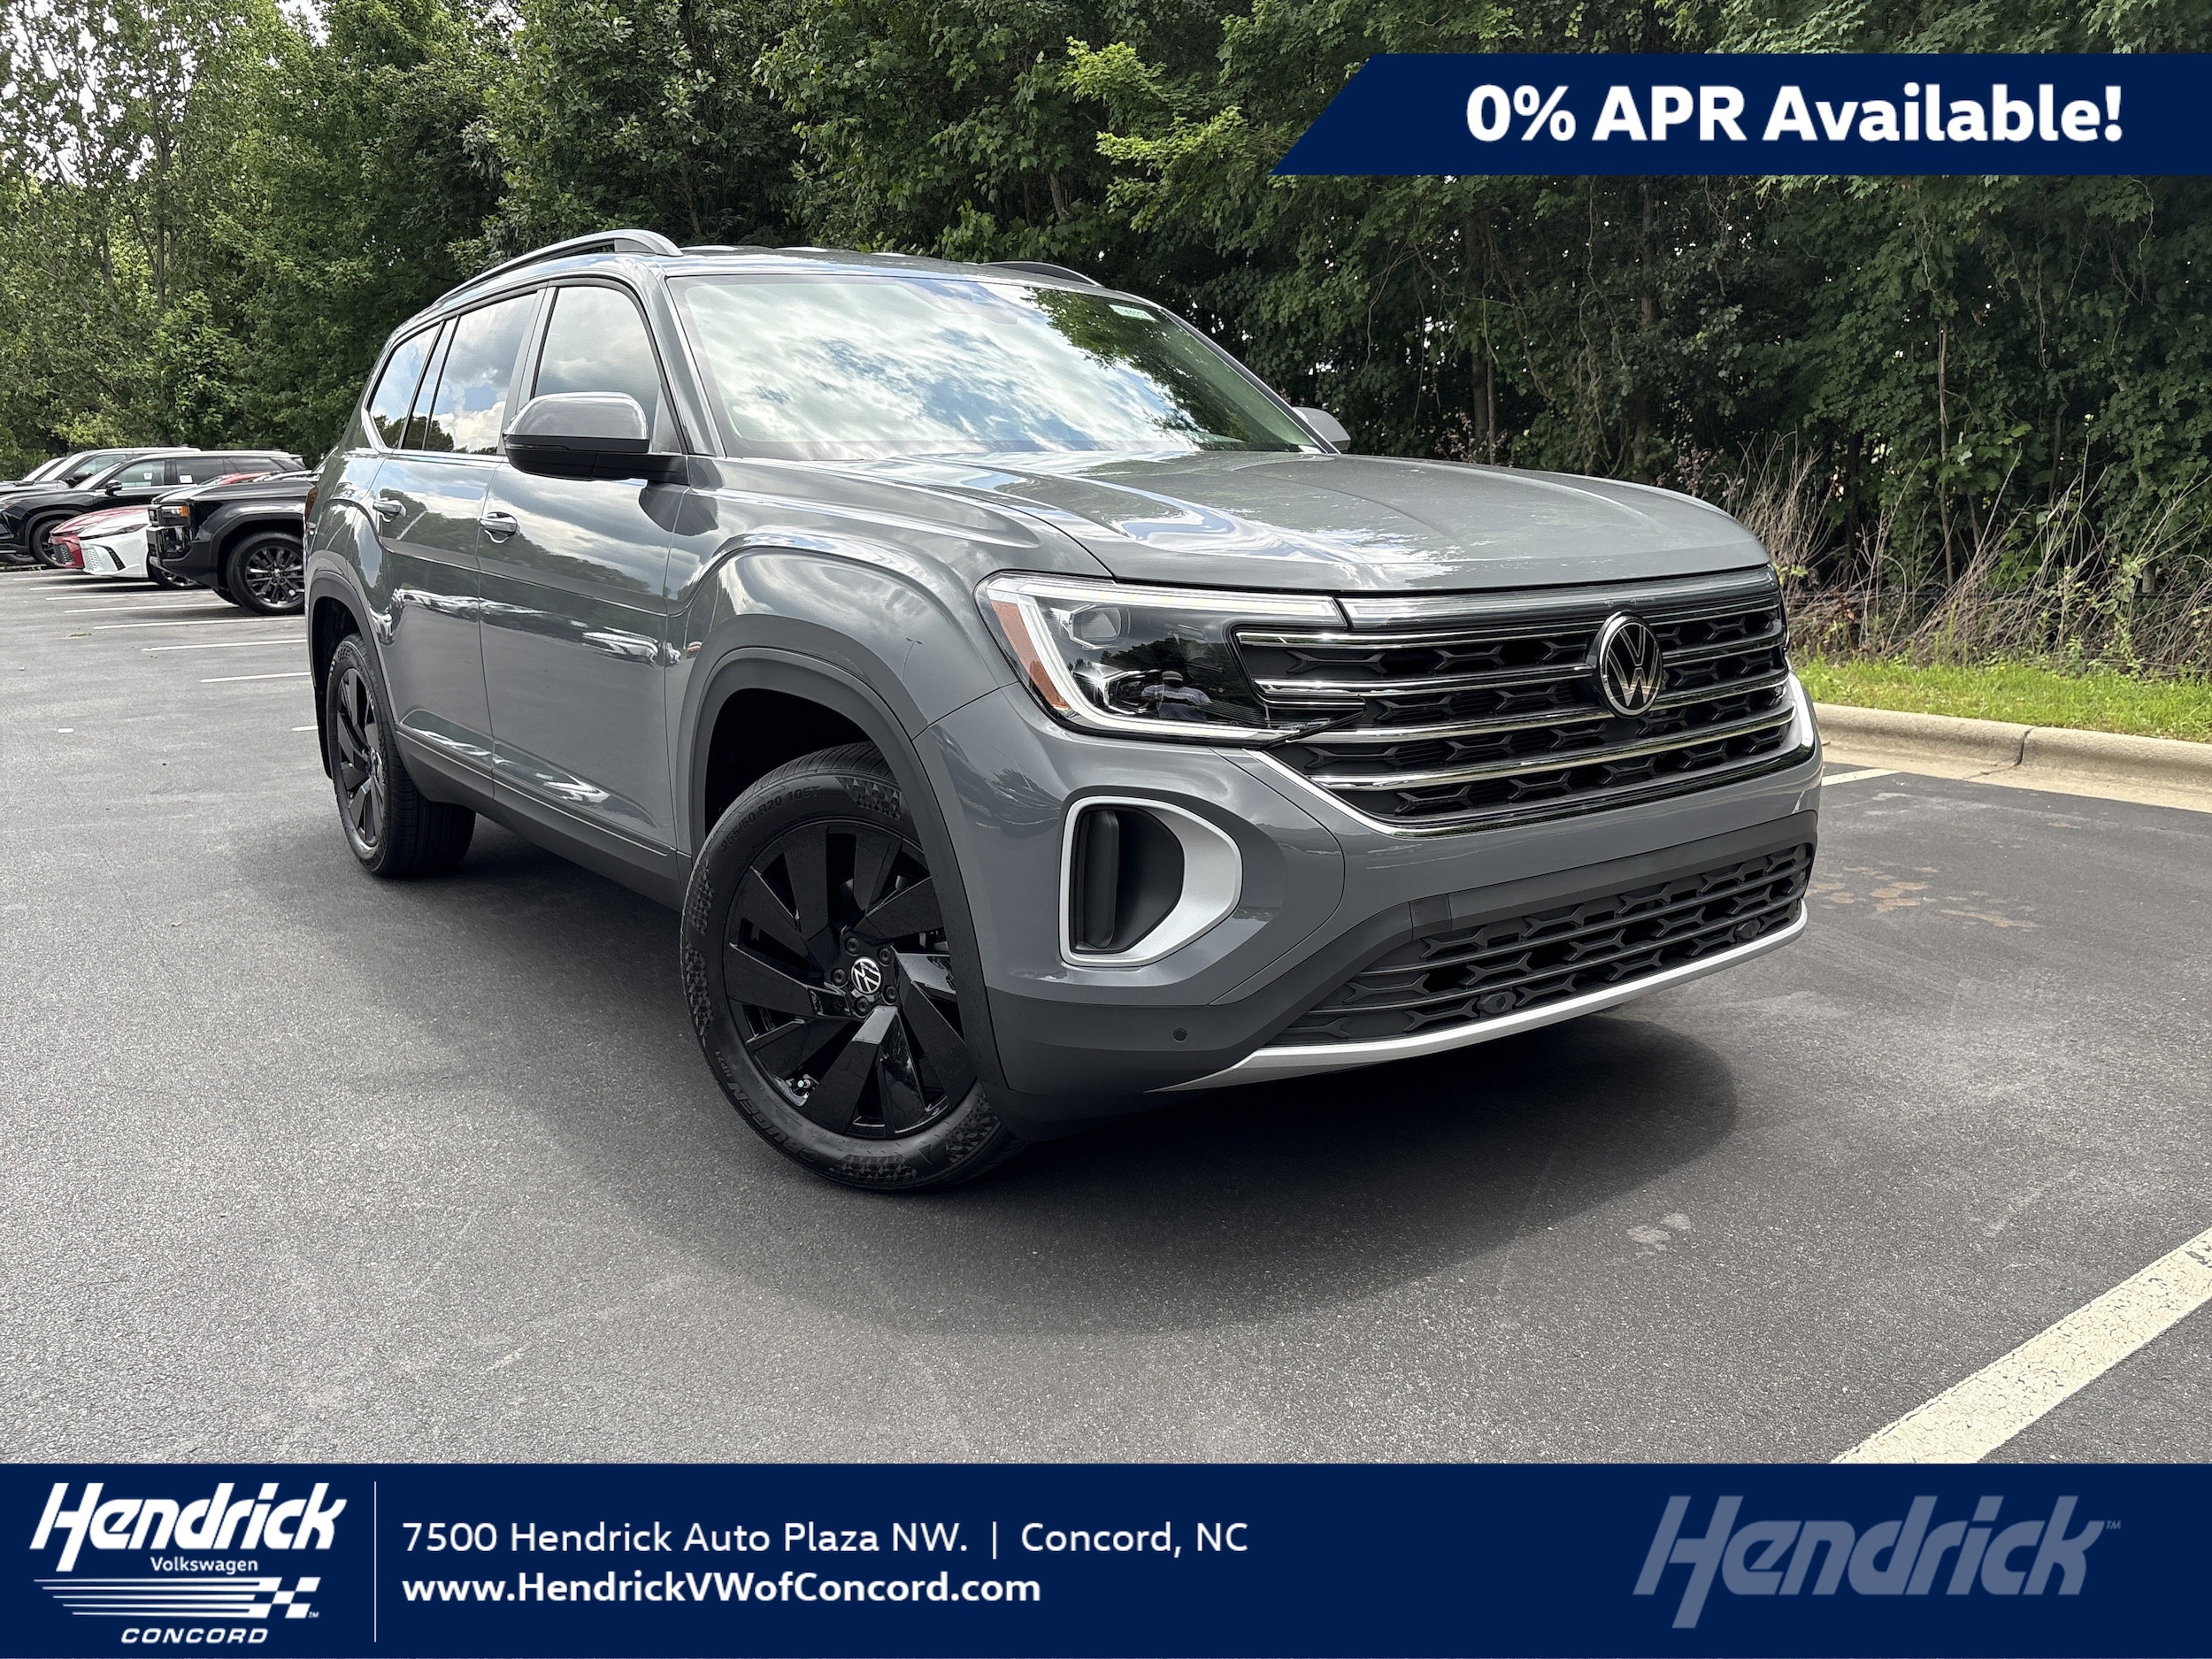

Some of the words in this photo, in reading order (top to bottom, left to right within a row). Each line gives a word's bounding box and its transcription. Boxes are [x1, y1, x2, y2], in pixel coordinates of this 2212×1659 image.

[758, 795, 783, 816] R20
[715, 1049, 733, 1078] HP71
[726, 1081, 819, 1163] CRUGEN
